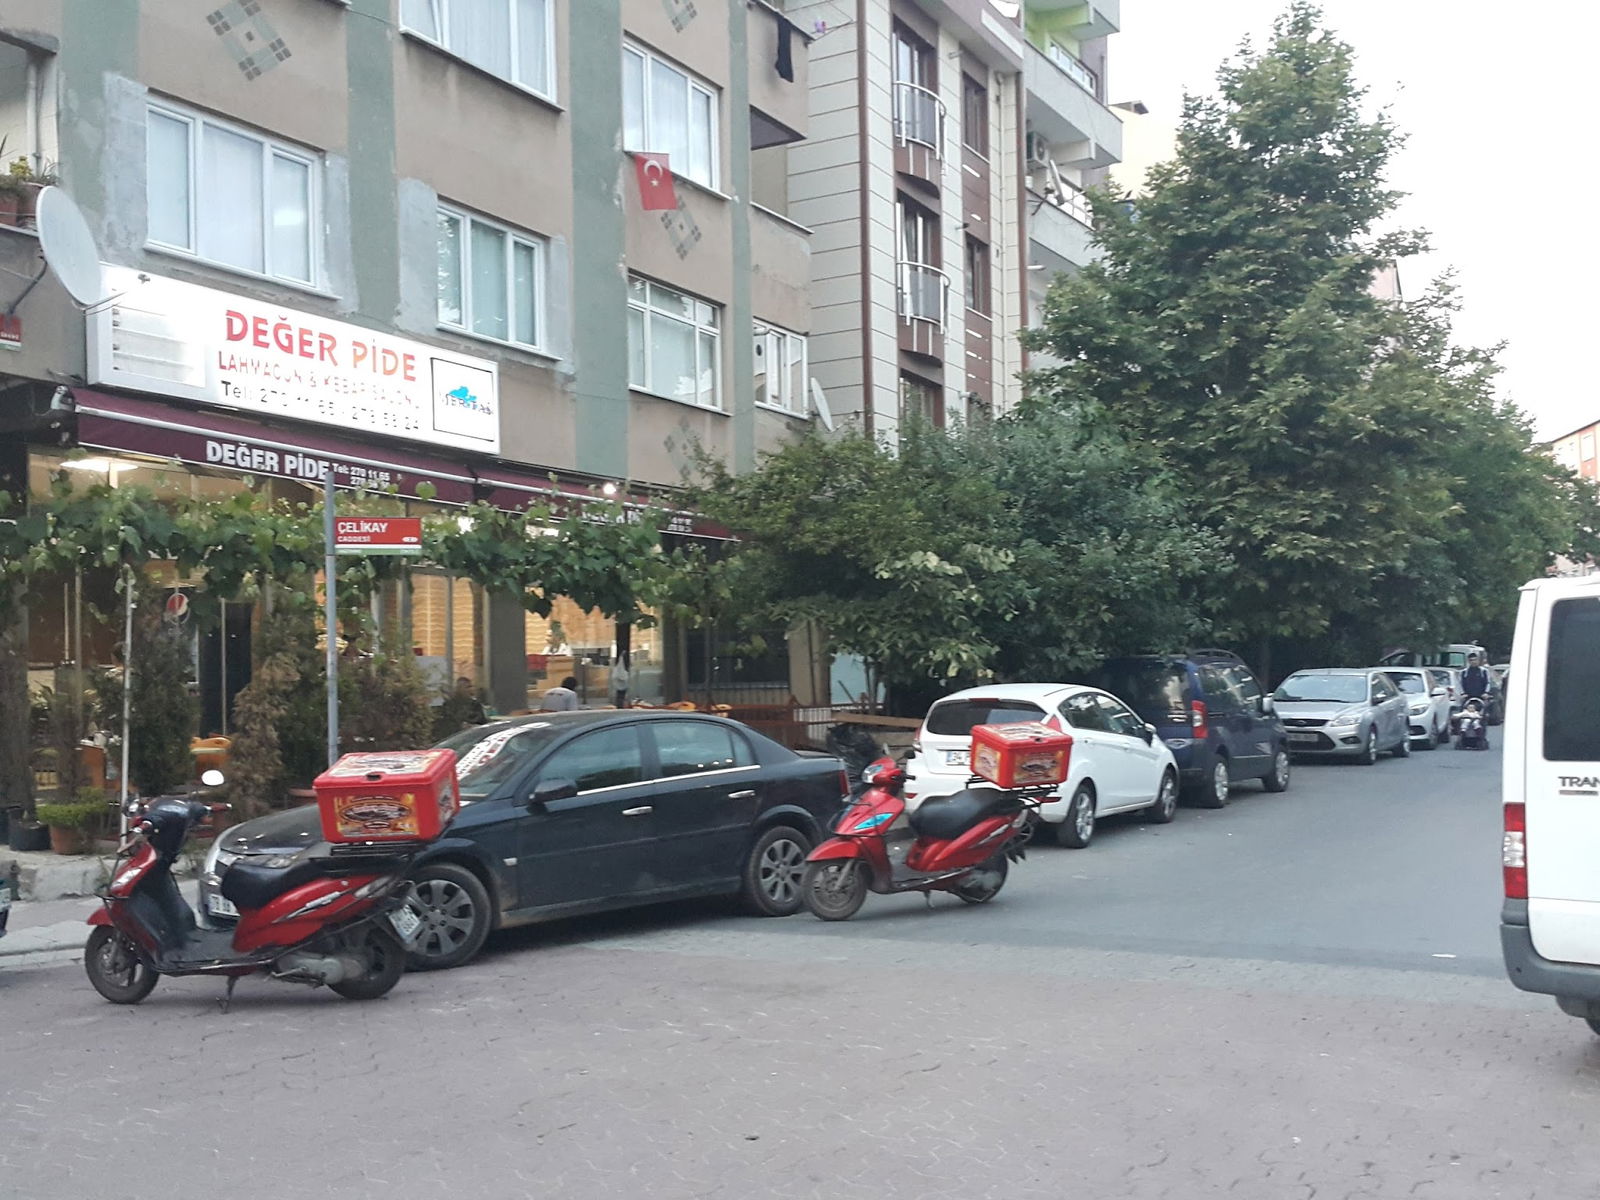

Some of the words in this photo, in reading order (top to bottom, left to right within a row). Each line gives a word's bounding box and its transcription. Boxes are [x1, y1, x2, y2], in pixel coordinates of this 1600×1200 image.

[225, 309, 338, 366] DEĞER
[352, 338, 417, 382] PİDE
[206, 440, 279, 473] DEĞER
[284, 452, 330, 480] PİDE
[332, 462, 349, 475] Tel:
[350, 466, 367, 479] 270
[337, 520, 388, 534] ÇELİKAY
